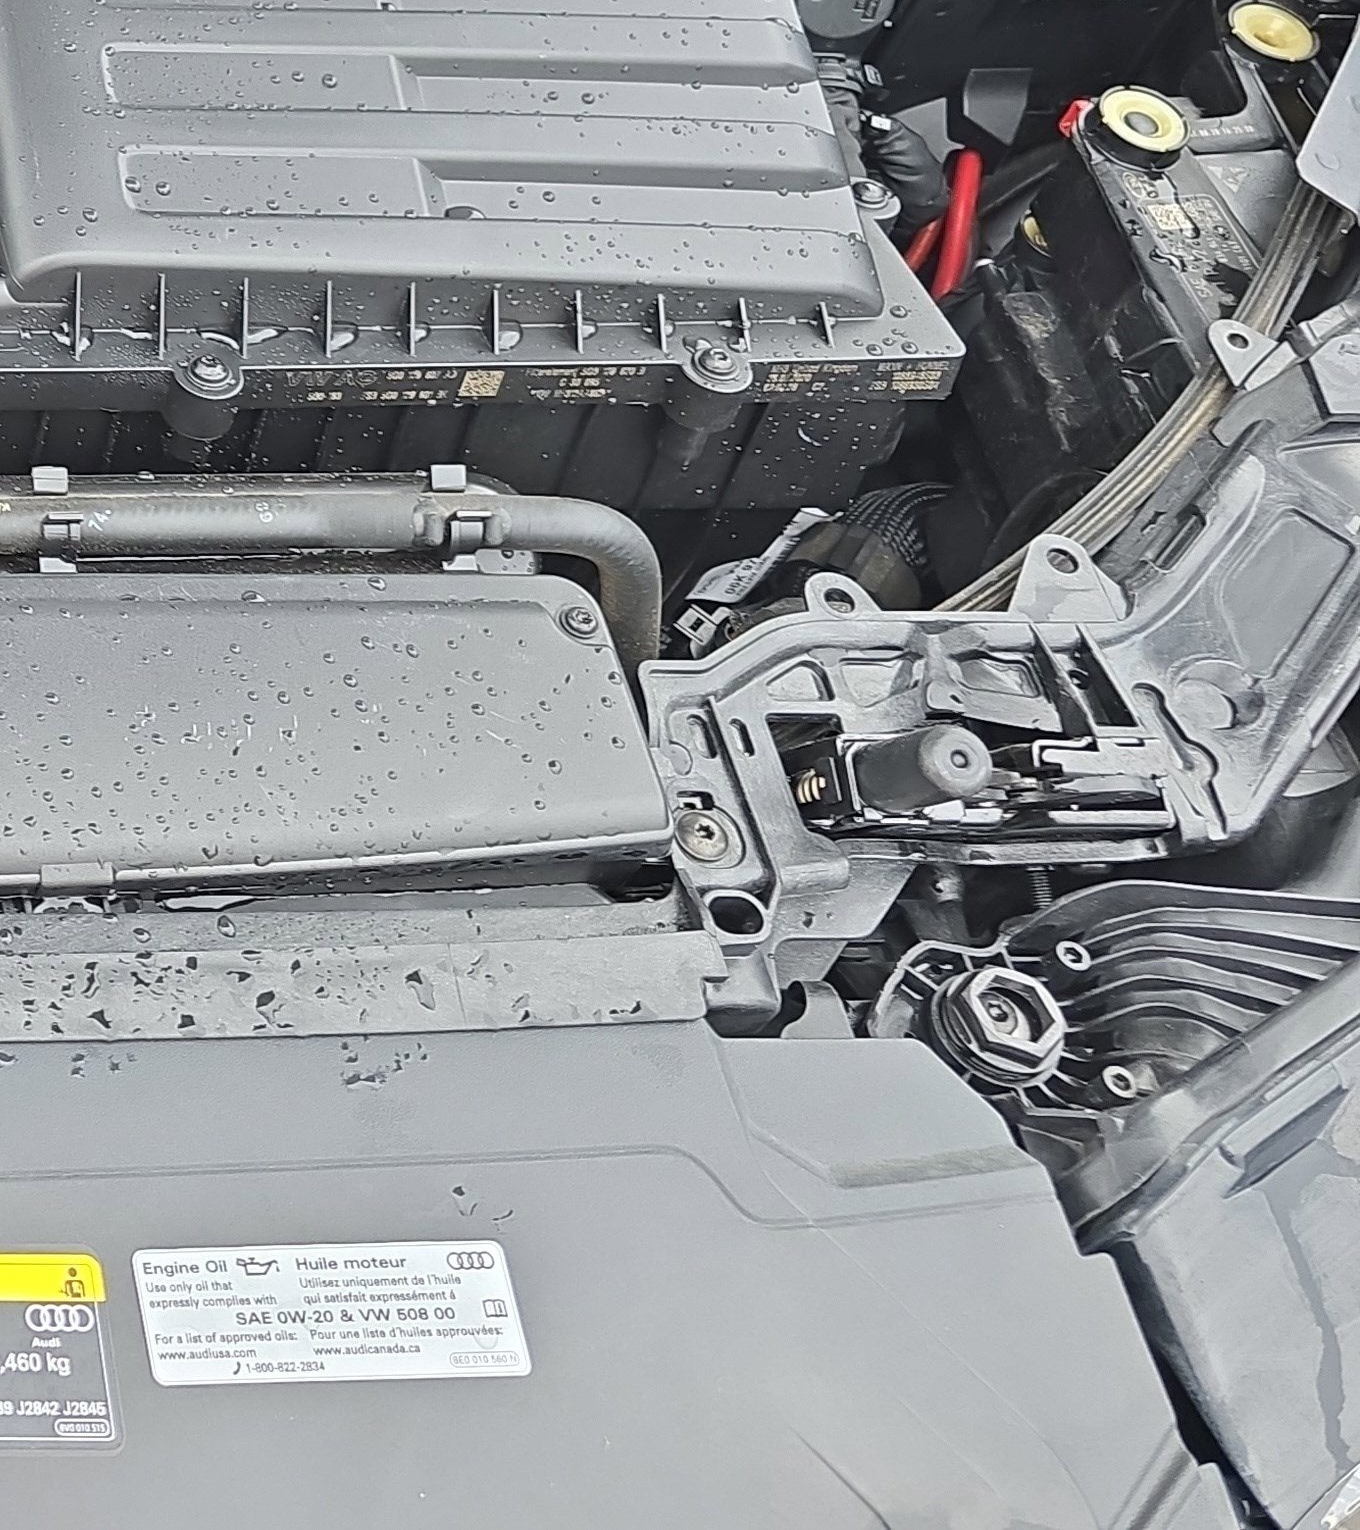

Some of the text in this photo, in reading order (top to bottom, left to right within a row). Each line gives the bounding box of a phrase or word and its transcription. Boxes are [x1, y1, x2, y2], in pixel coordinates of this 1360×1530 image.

[143, 1256, 406, 1277] Engine Oil Huile moteur
[145, 1281, 233, 1293] Use only oil that
[299, 1277, 341, 1288] Utilisez
[342, 1276, 409, 1288] uniquement
[411, 1276, 425, 1285] de
[150, 1295, 277, 1310] expressly complies with
[304, 1291, 446, 1305] qui satisfait expressément
[236, 1307, 456, 1325] SAE 0W-20 & VW 508 00
[154, 1334, 174, 1345] For
[186, 1333, 202, 1343] list
[206, 1332, 216, 1343] of
[220, 1332, 272, 1344] approved
[275, 1331, 298, 1341] oils:
[310, 1330, 336, 1340] Pour
[339, 1331, 359, 1339] une
[363, 1328, 386, 1339] liste
[435, 1325, 504, 1338] approuvées:
[31, 1336, 62, 1349] Audi
[158, 1348, 257, 1360] www.audiusa.com
[313, 1344, 420, 1356] www.audicanada.ca
[46, 1352, 72, 1377] kg
[246, 1361, 325, 1373] 1-800-822-2834
[16, 1400, 60, 1416] J2842
